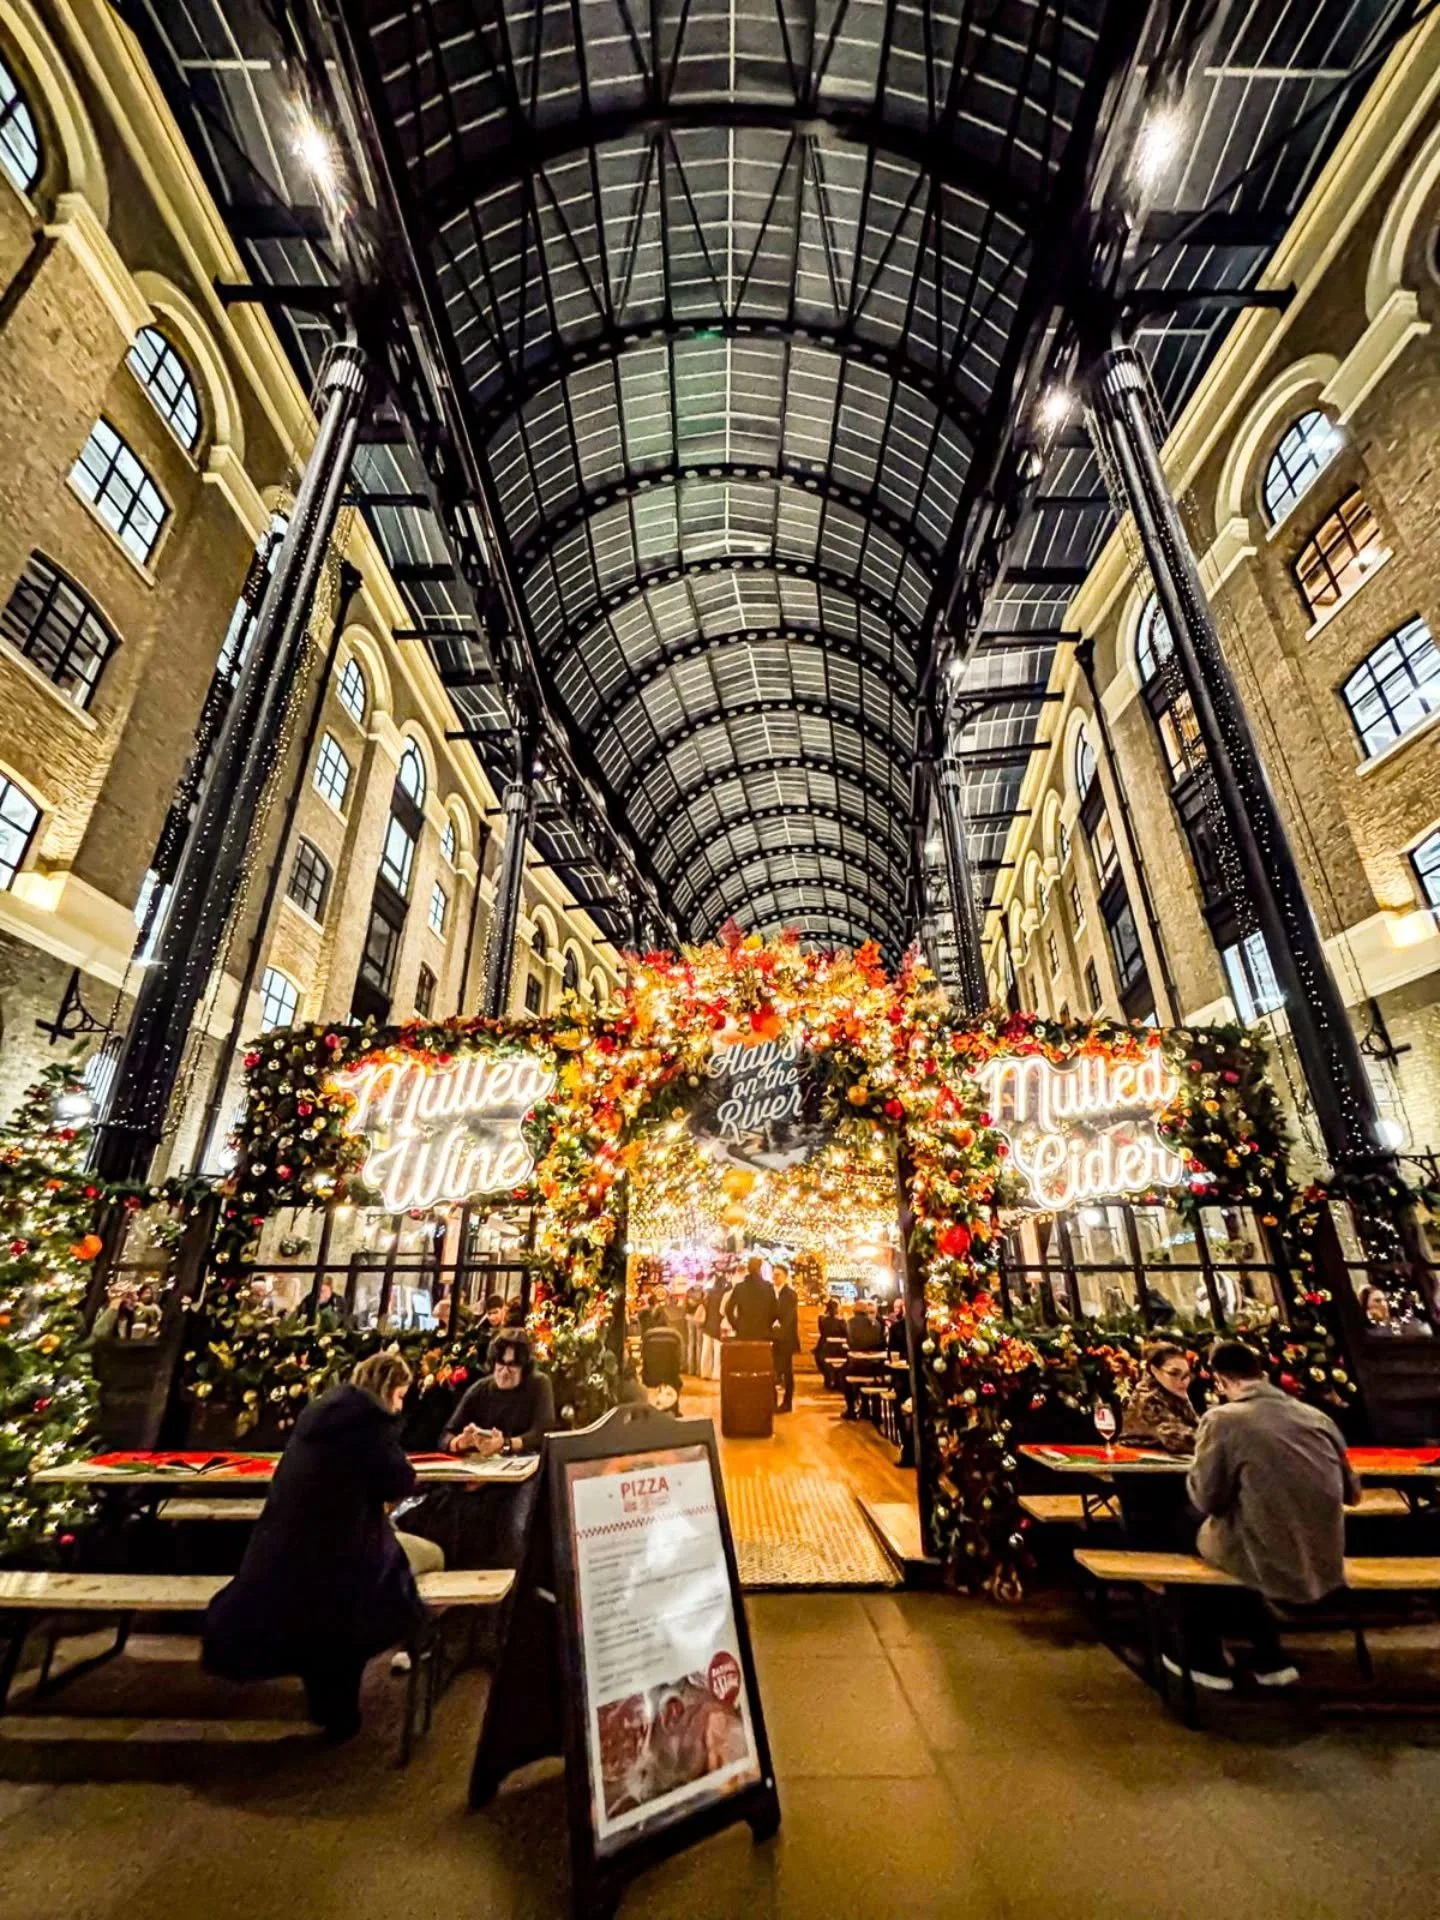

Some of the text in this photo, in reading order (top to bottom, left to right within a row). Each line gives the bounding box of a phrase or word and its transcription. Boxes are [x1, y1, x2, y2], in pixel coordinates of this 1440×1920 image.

[338, 1055, 554, 1134] Mulled
[717, 1085, 803, 1145] River
[732, 1063, 798, 1100] on the
[972, 1050, 1179, 1133] Mulled
[365, 1124, 533, 1212] Wine
[1014, 1134, 1180, 1208] Cider
[620, 1476, 669, 1498] PIZZA
